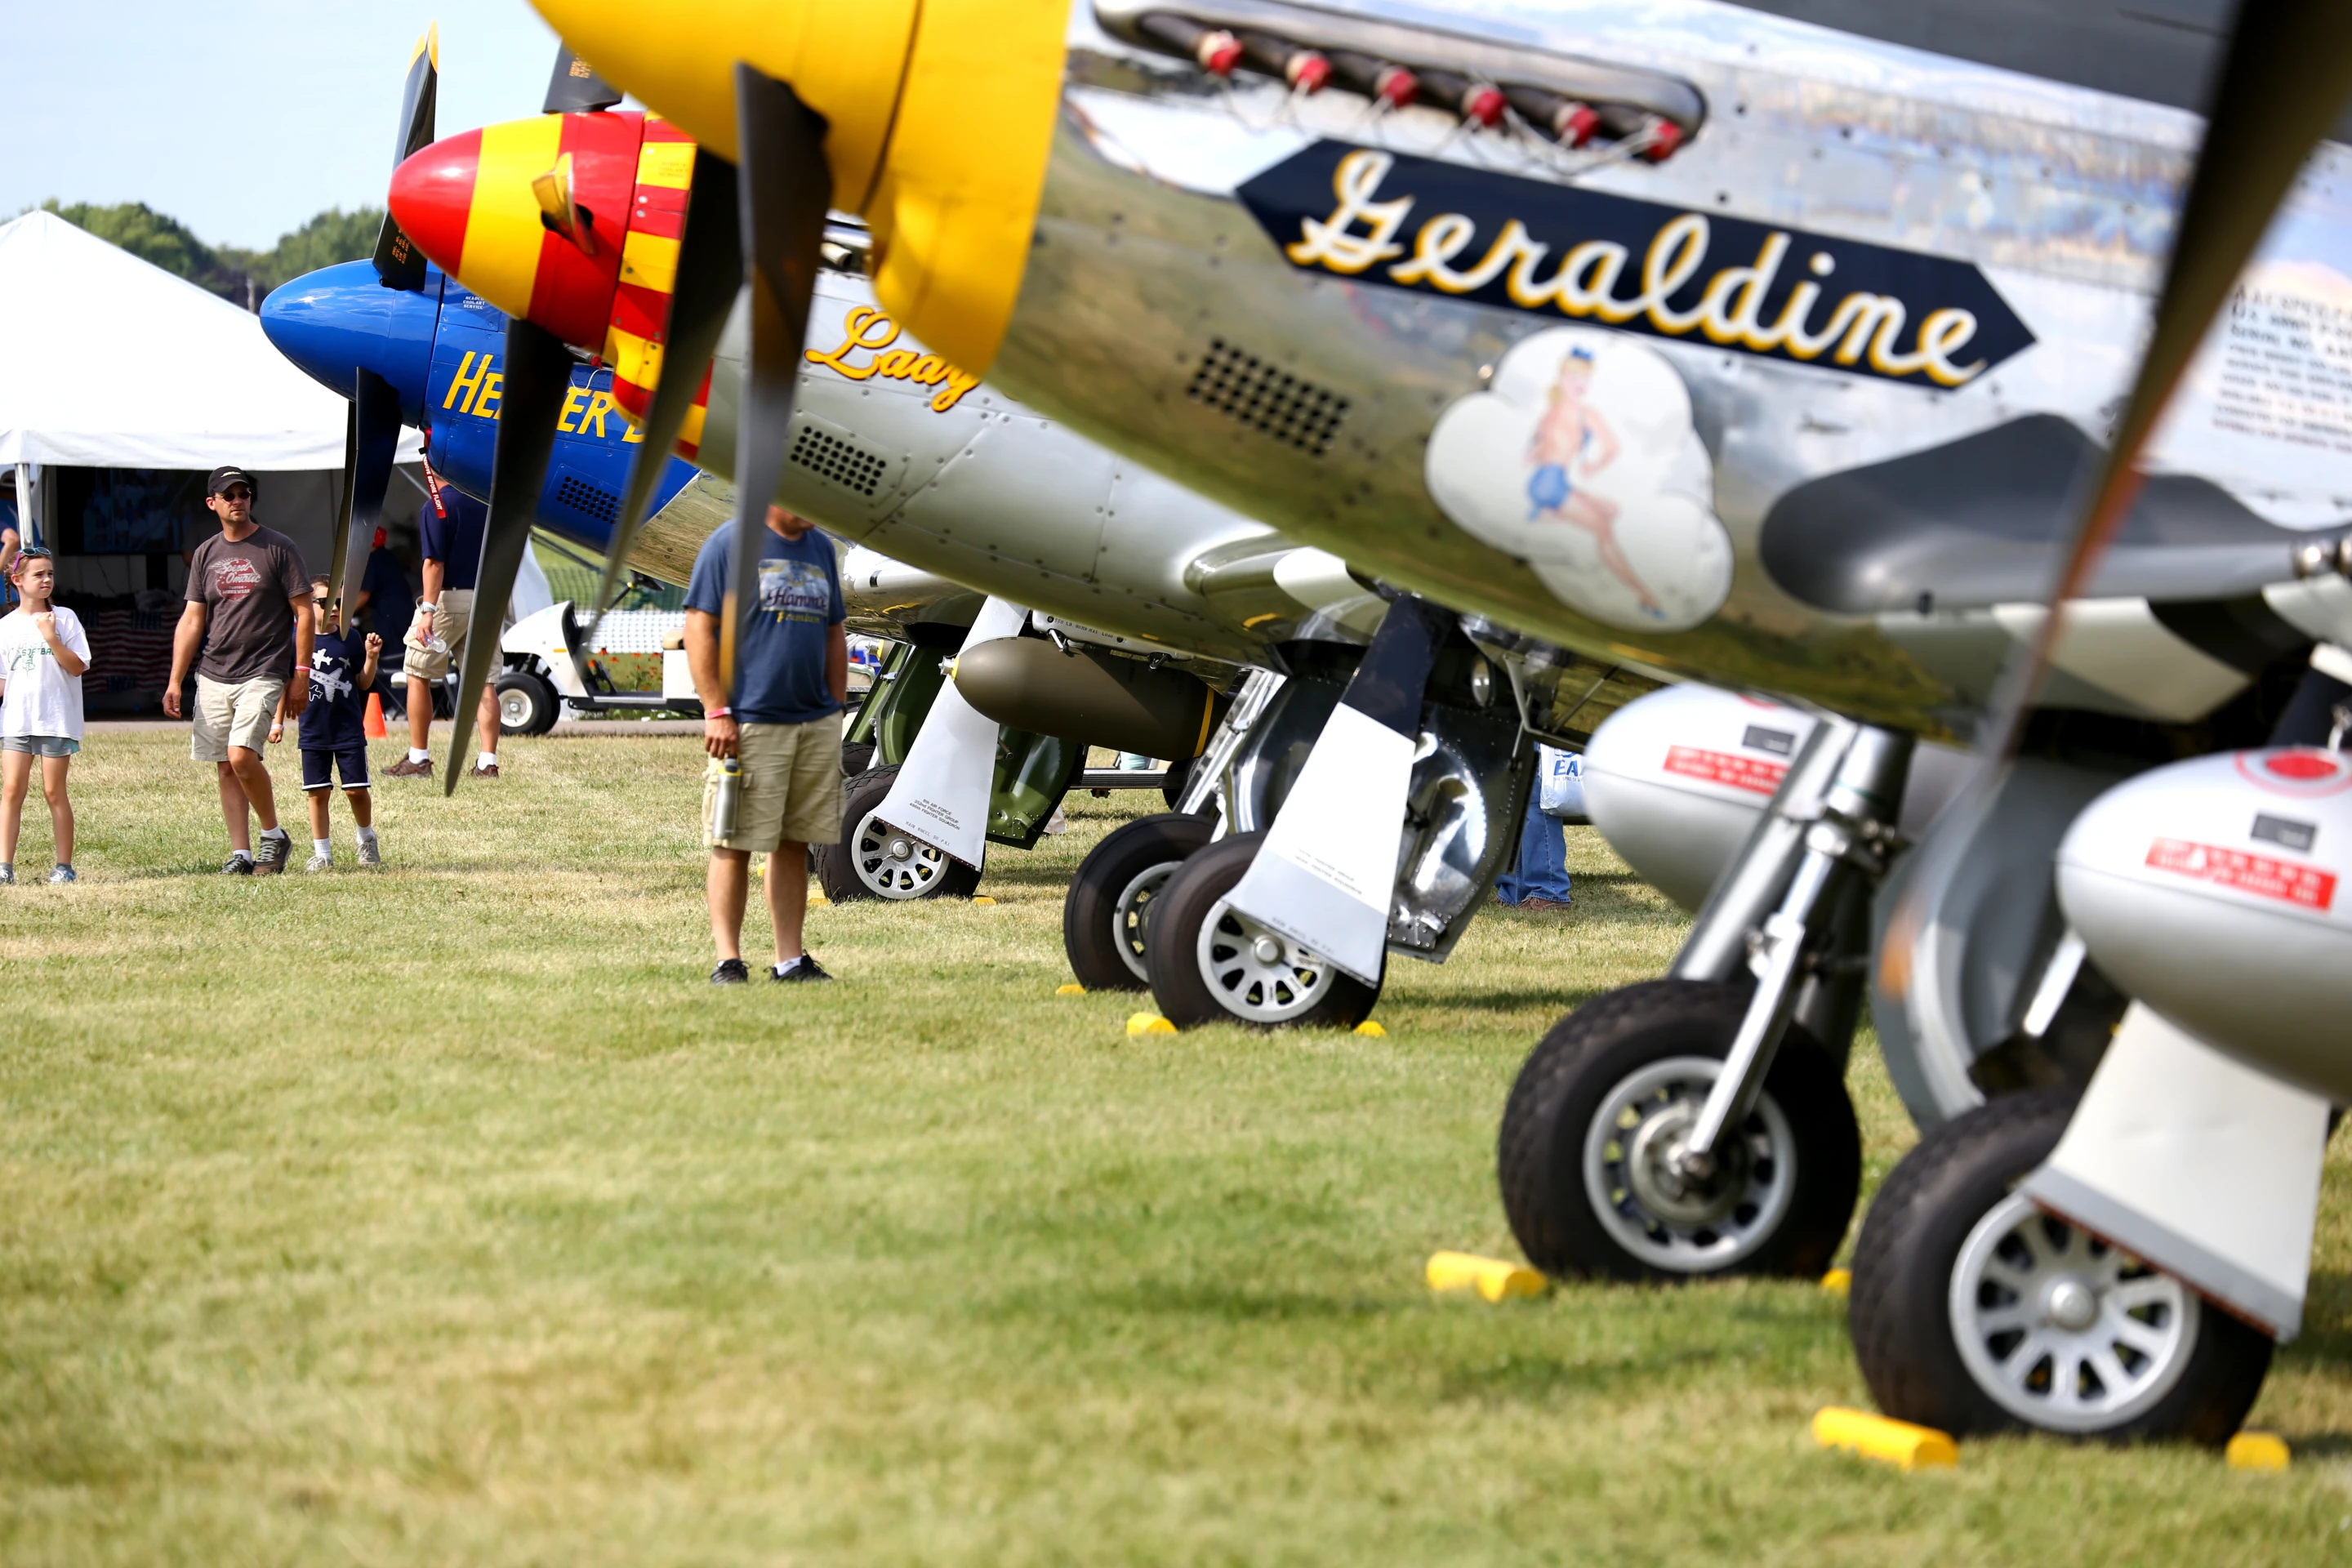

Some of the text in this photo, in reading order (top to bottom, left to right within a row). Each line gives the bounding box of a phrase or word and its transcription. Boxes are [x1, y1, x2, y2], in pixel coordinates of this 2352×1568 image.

[1285, 149, 1988, 386] Geraldine
[427, 475, 437, 493] BEFORE
[433, 494, 443, 510] FLIGHT
[921, 808, 938, 819] FIGHTER
[938, 817, 961, 831] SQUADRON
[927, 805, 944, 817] FIGHTER
[944, 814, 960, 824] GROUP
[938, 806, 952, 816] FORCE
